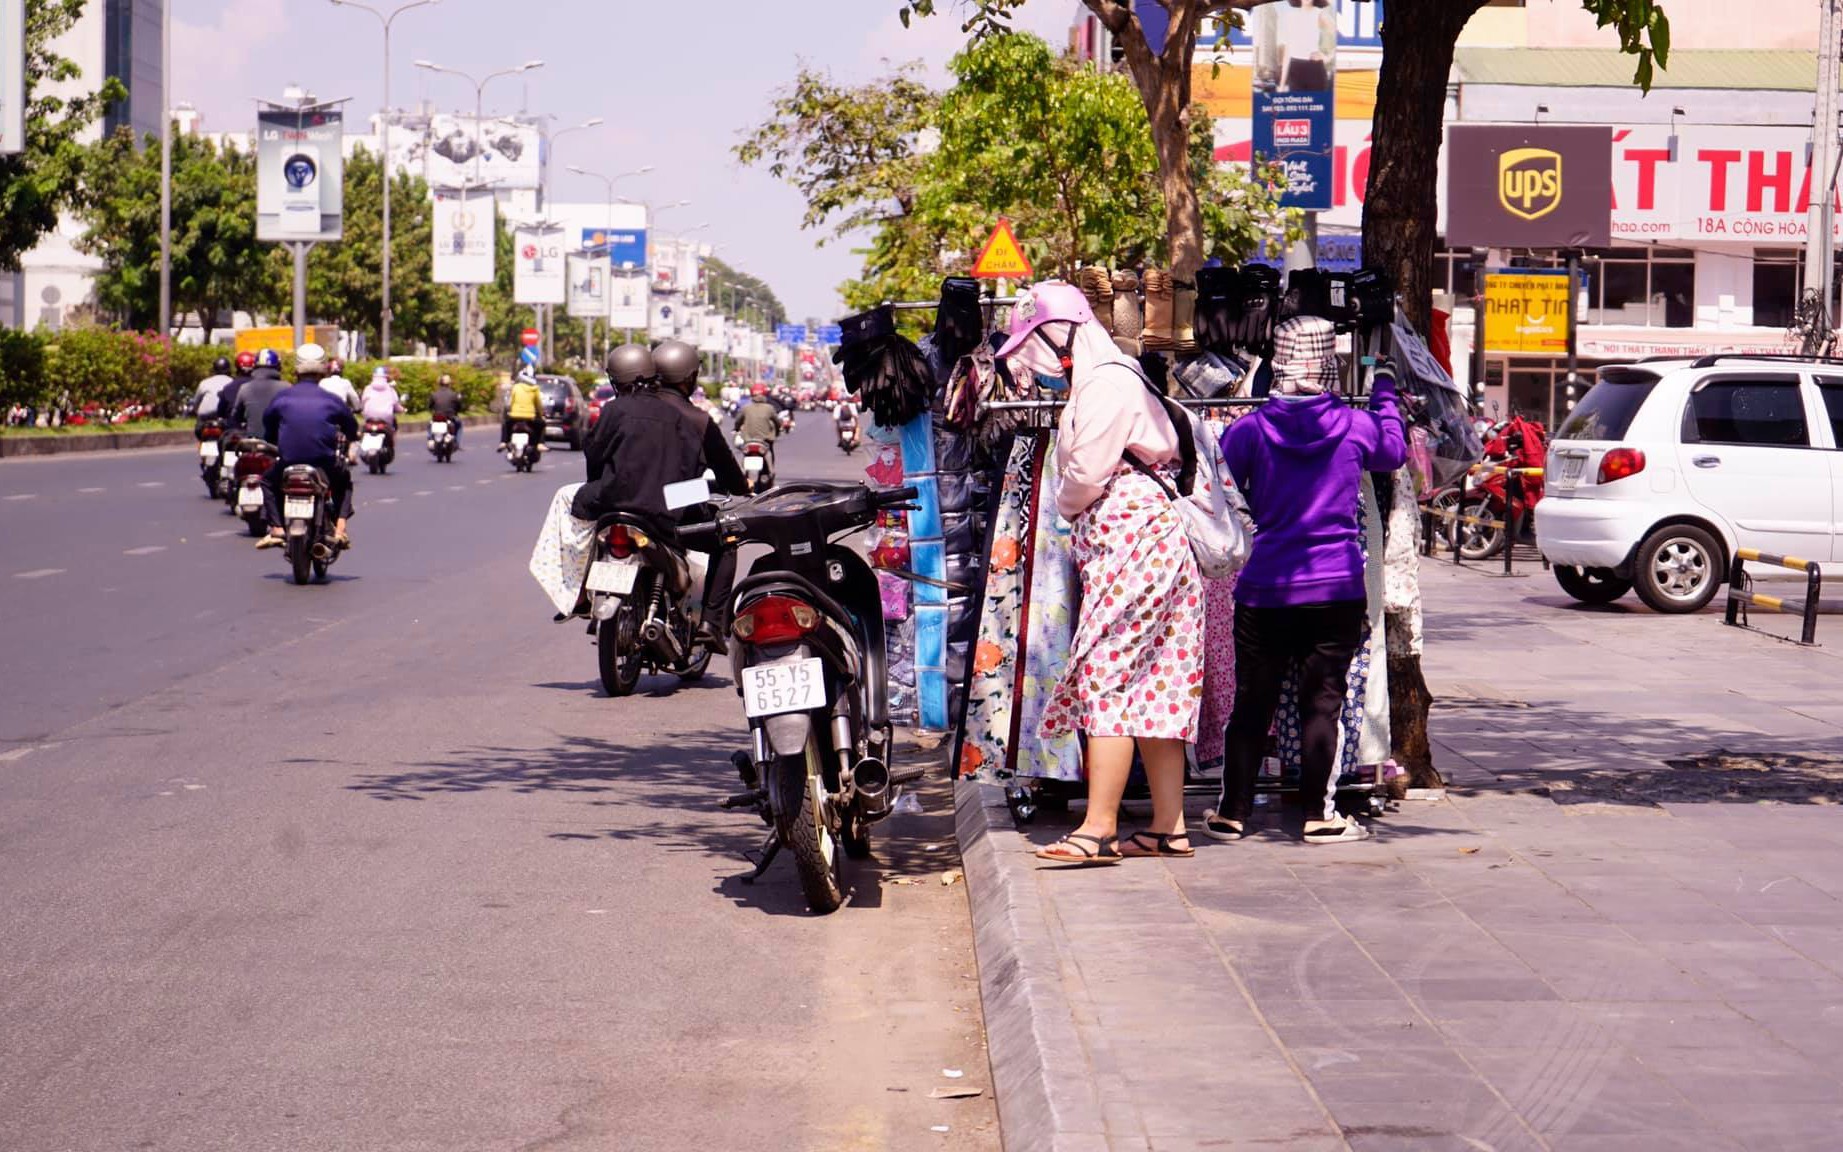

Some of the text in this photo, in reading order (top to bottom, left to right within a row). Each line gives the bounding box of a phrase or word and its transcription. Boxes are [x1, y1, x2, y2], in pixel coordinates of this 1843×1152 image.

[264, 130, 279, 140] LG
[1505, 169, 1557, 208] ups
[1698, 218, 1727, 233] 18A
[540, 247, 558, 258] LG
[756, 684, 811, 711] 6527
